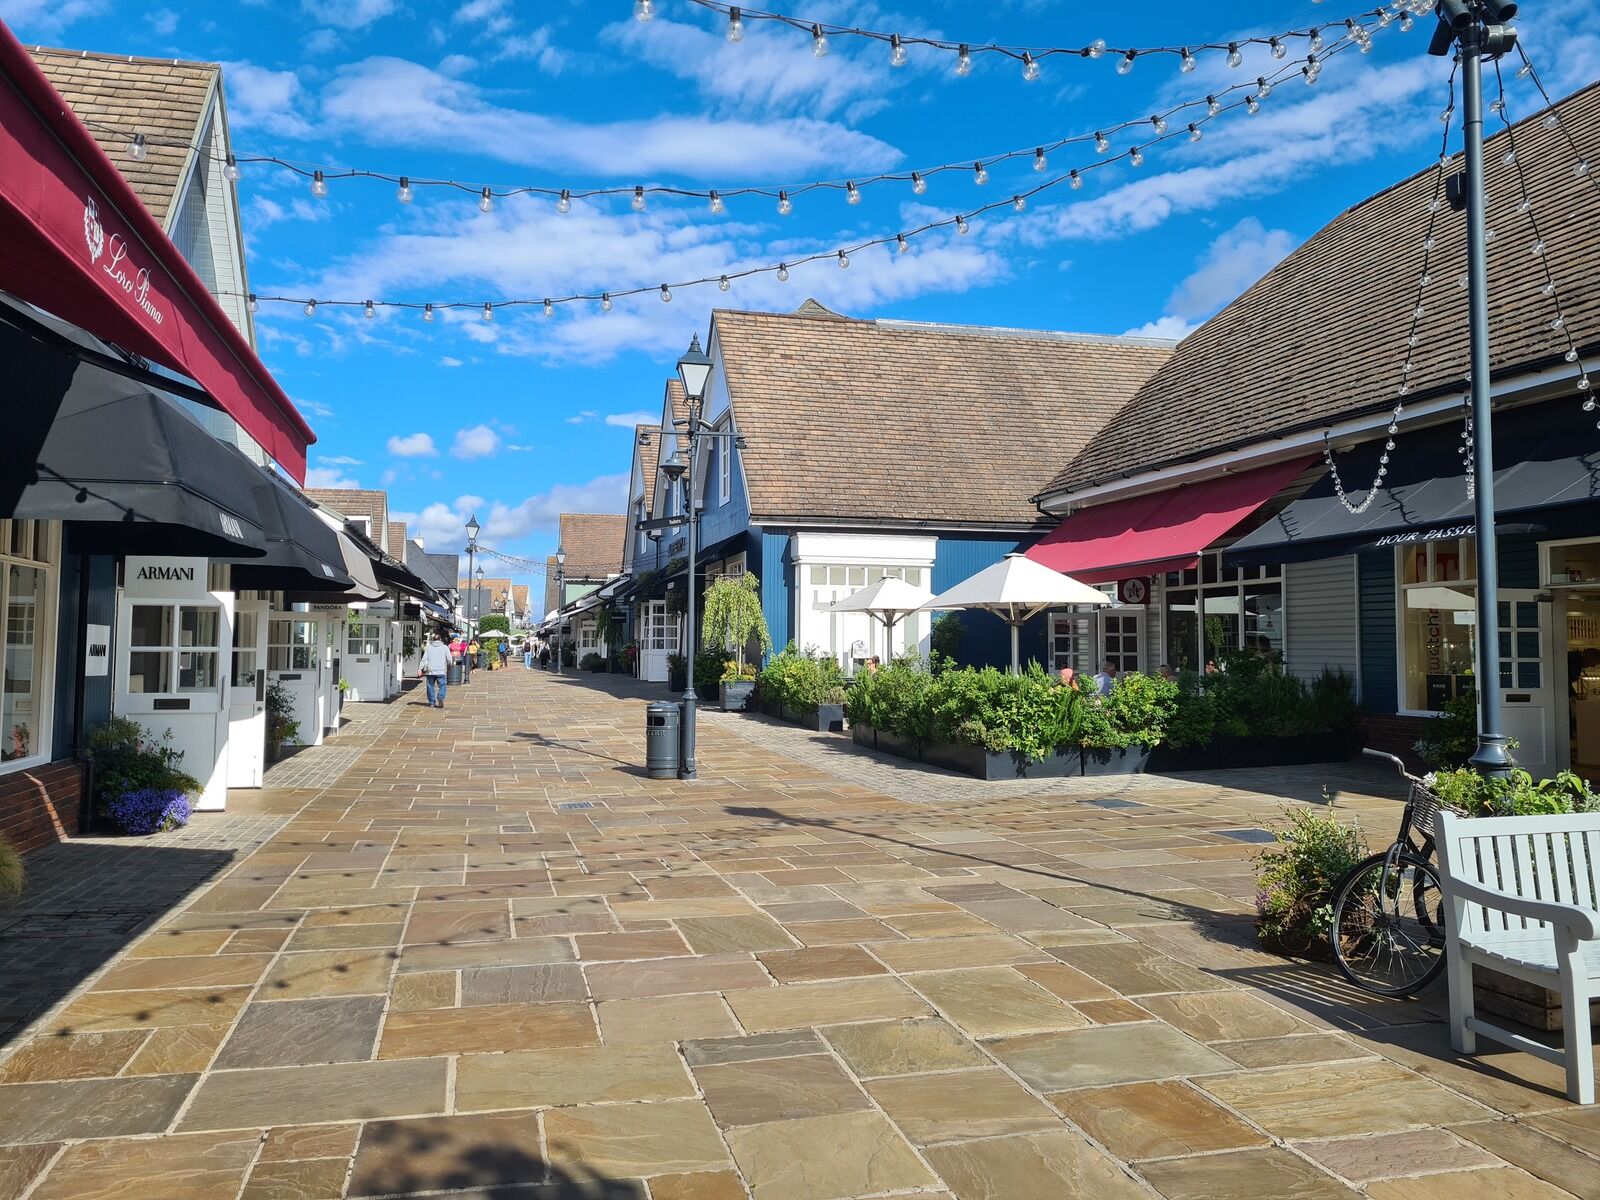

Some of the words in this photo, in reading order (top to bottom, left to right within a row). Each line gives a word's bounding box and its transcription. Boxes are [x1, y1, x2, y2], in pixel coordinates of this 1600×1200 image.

[103, 233, 134, 293] Loro
[134, 268, 163, 324] Piana
[1375, 531, 1420, 547] HOUR
[1423, 525, 1477, 540] PASSIO
[137, 566, 194, 580] ARMANI
[88, 644, 107, 657] ARMANI
[1428, 612, 1440, 675] watch
